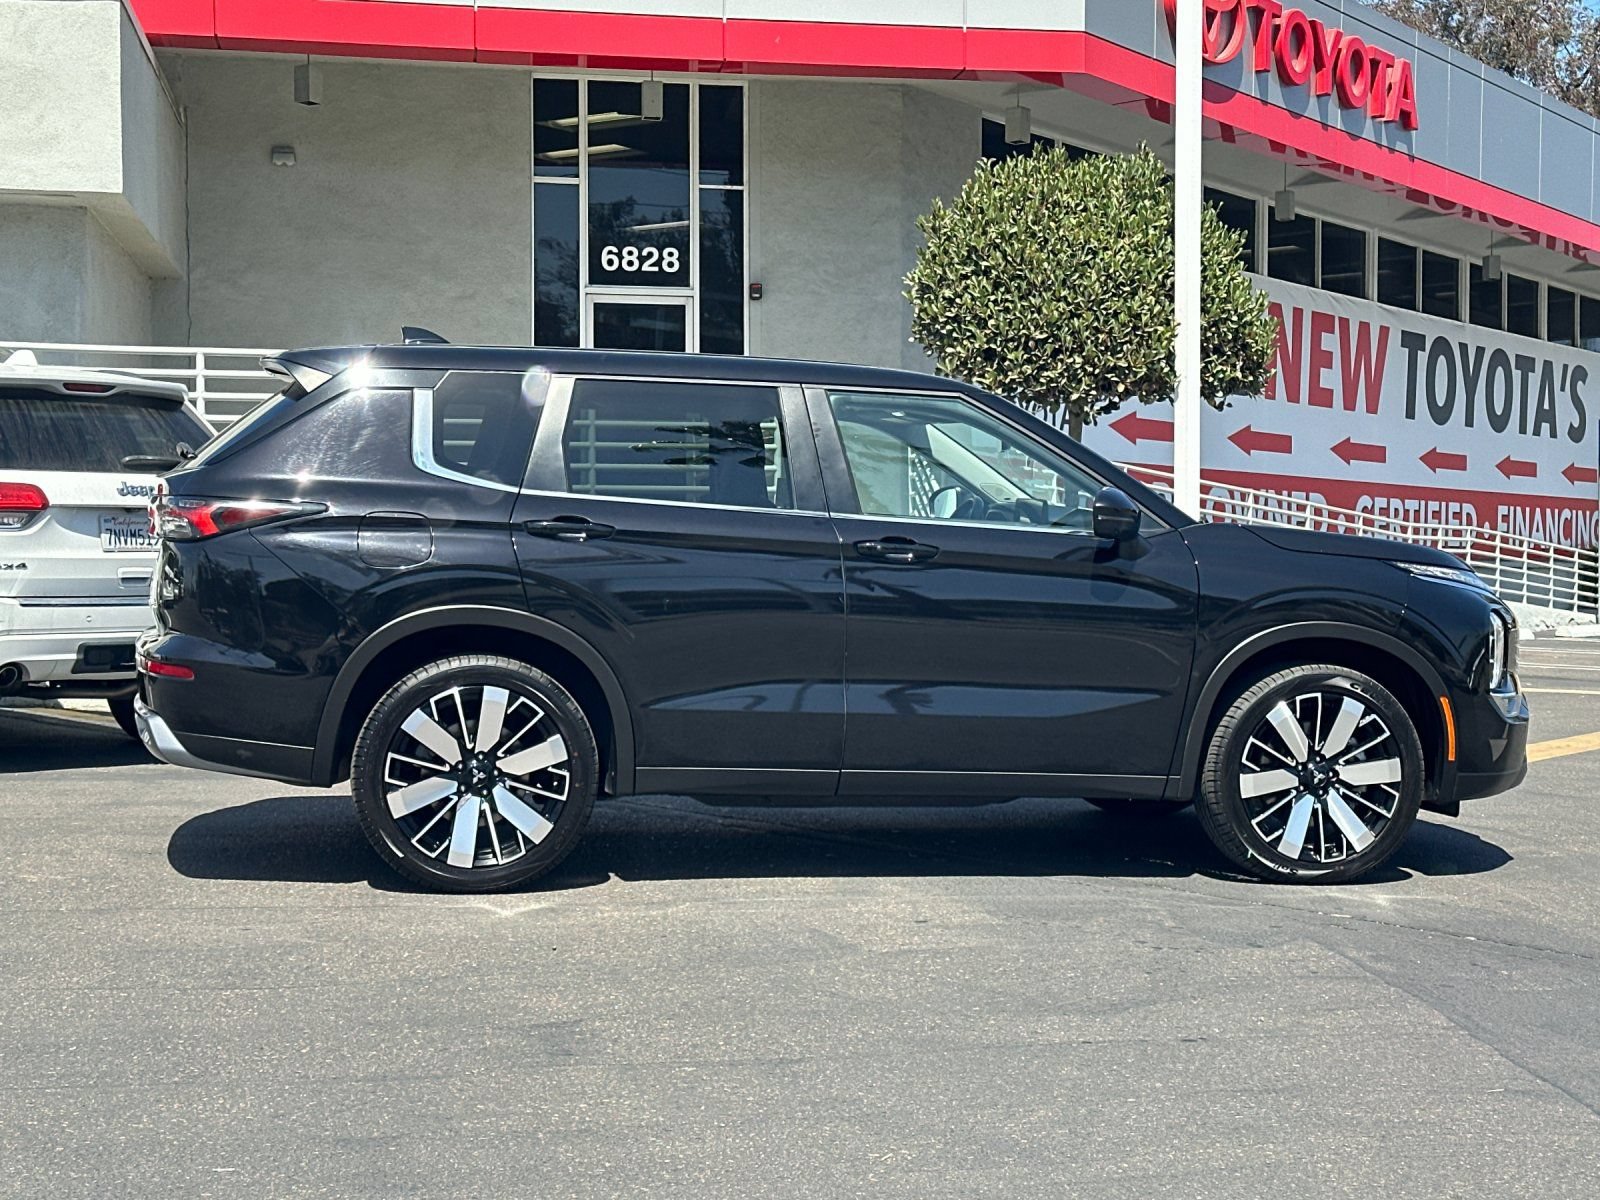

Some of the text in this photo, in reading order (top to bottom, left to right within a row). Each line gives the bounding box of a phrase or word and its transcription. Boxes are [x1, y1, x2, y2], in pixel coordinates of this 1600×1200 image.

[1246, 0, 1418, 130] TOYOTA
[601, 245, 680, 273] 6828
[1264, 301, 1589, 444] NEW TOYOTA'S
[116, 481, 155, 499] Jeep
[1205, 486, 1329, 533] OWNED
[1355, 494, 1478, 547] CERTIFIED
